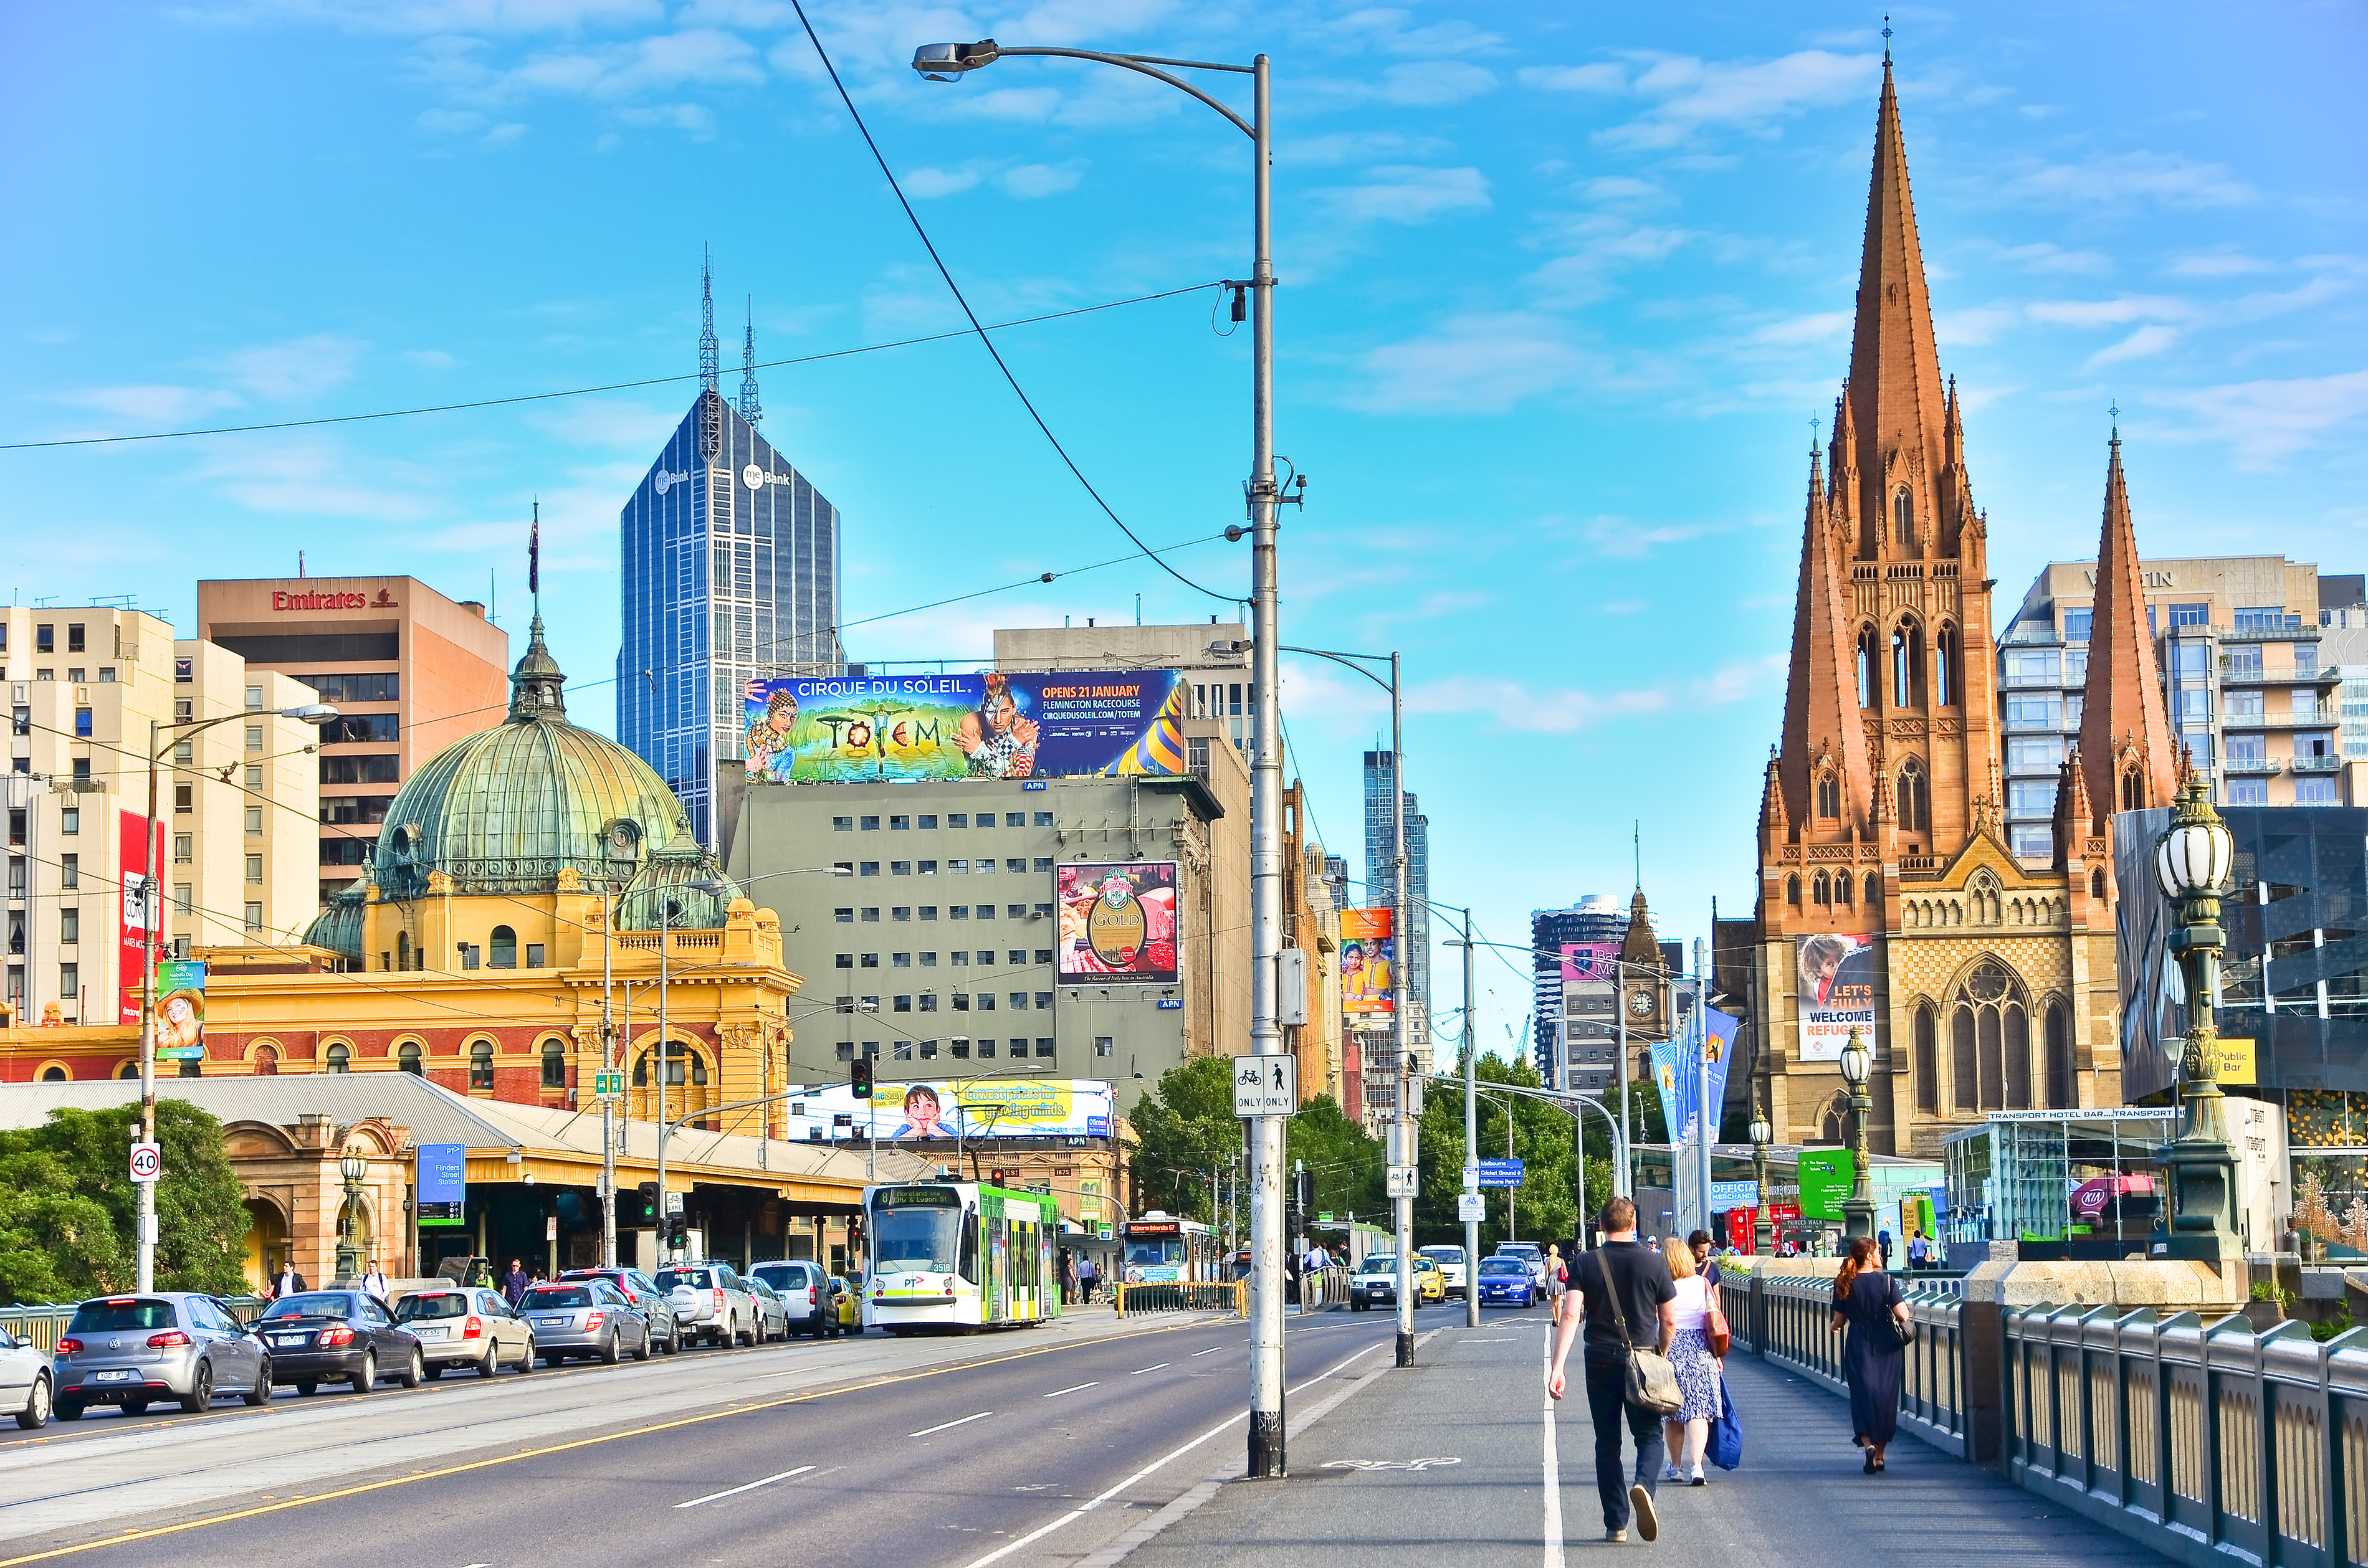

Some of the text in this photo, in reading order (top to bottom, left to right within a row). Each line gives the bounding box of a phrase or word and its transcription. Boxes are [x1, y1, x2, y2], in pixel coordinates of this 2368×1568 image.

[671, 470, 689, 484] Bank
[765, 471, 790, 486] Bank
[272, 589, 366, 611] Emirates
[798, 681, 866, 699] CIRQUE
[872, 680, 897, 695] DU
[1042, 685, 1140, 698] OPENS 21 JANUARY
[1043, 699, 1140, 709] FLEMINGTON RACECOURSE
[1043, 710, 1140, 720] CIRQUEDUSOLEIL.COM/TOTEM
[1093, 913, 1140, 927] GOLD
[1835, 985, 1871, 997] LET'S
[1830, 998, 1871, 1009] FULLY
[1810, 1011, 1872, 1022] WELCOME
[2219, 1052, 2248, 1061] Public
[2224, 1063, 2241, 1071] Bar
[966, 1085, 1056, 1103] Lowest prices for
[1238, 1098, 1261, 1107] ONLY
[1266, 1097, 1289, 1106] ONLY
[1031, 1102, 1066, 1116] minds.
[1068, 1137, 1085, 1145] APN
[135, 1156, 155, 1169] 40
[1712, 1183, 1757, 1193] OFFICIA
[1783, 1184, 1800, 1195] VISITOR
[1872, 1185, 1893, 1193] OURNE
[882, 1192, 888, 1203] 8
[2085, 1192, 2101, 1202] KIA
